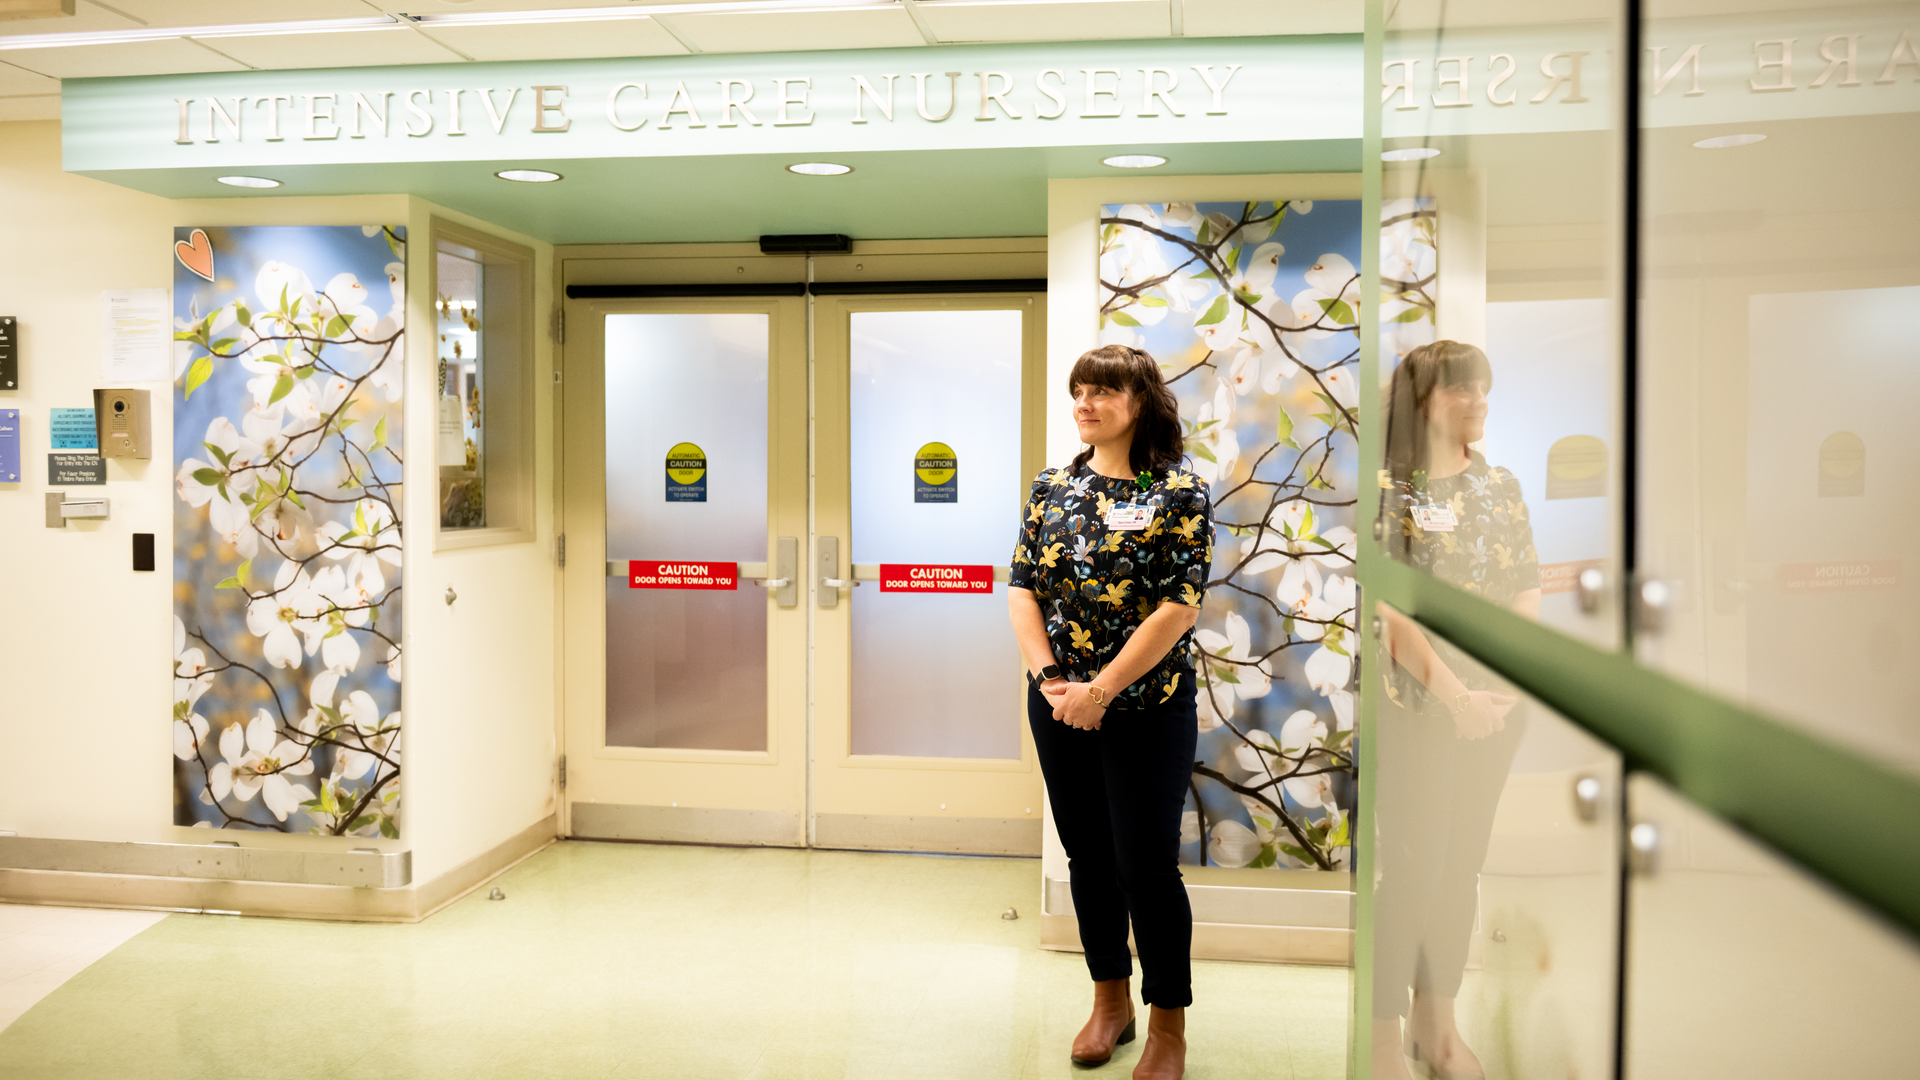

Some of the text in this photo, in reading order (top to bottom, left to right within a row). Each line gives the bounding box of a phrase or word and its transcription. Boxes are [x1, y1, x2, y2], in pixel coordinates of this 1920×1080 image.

[173, 64, 1243, 145] INTENSIVE CARE NURSERY
[658, 565, 708, 575] CAUTION
[910, 568, 962, 579] CAUTION
